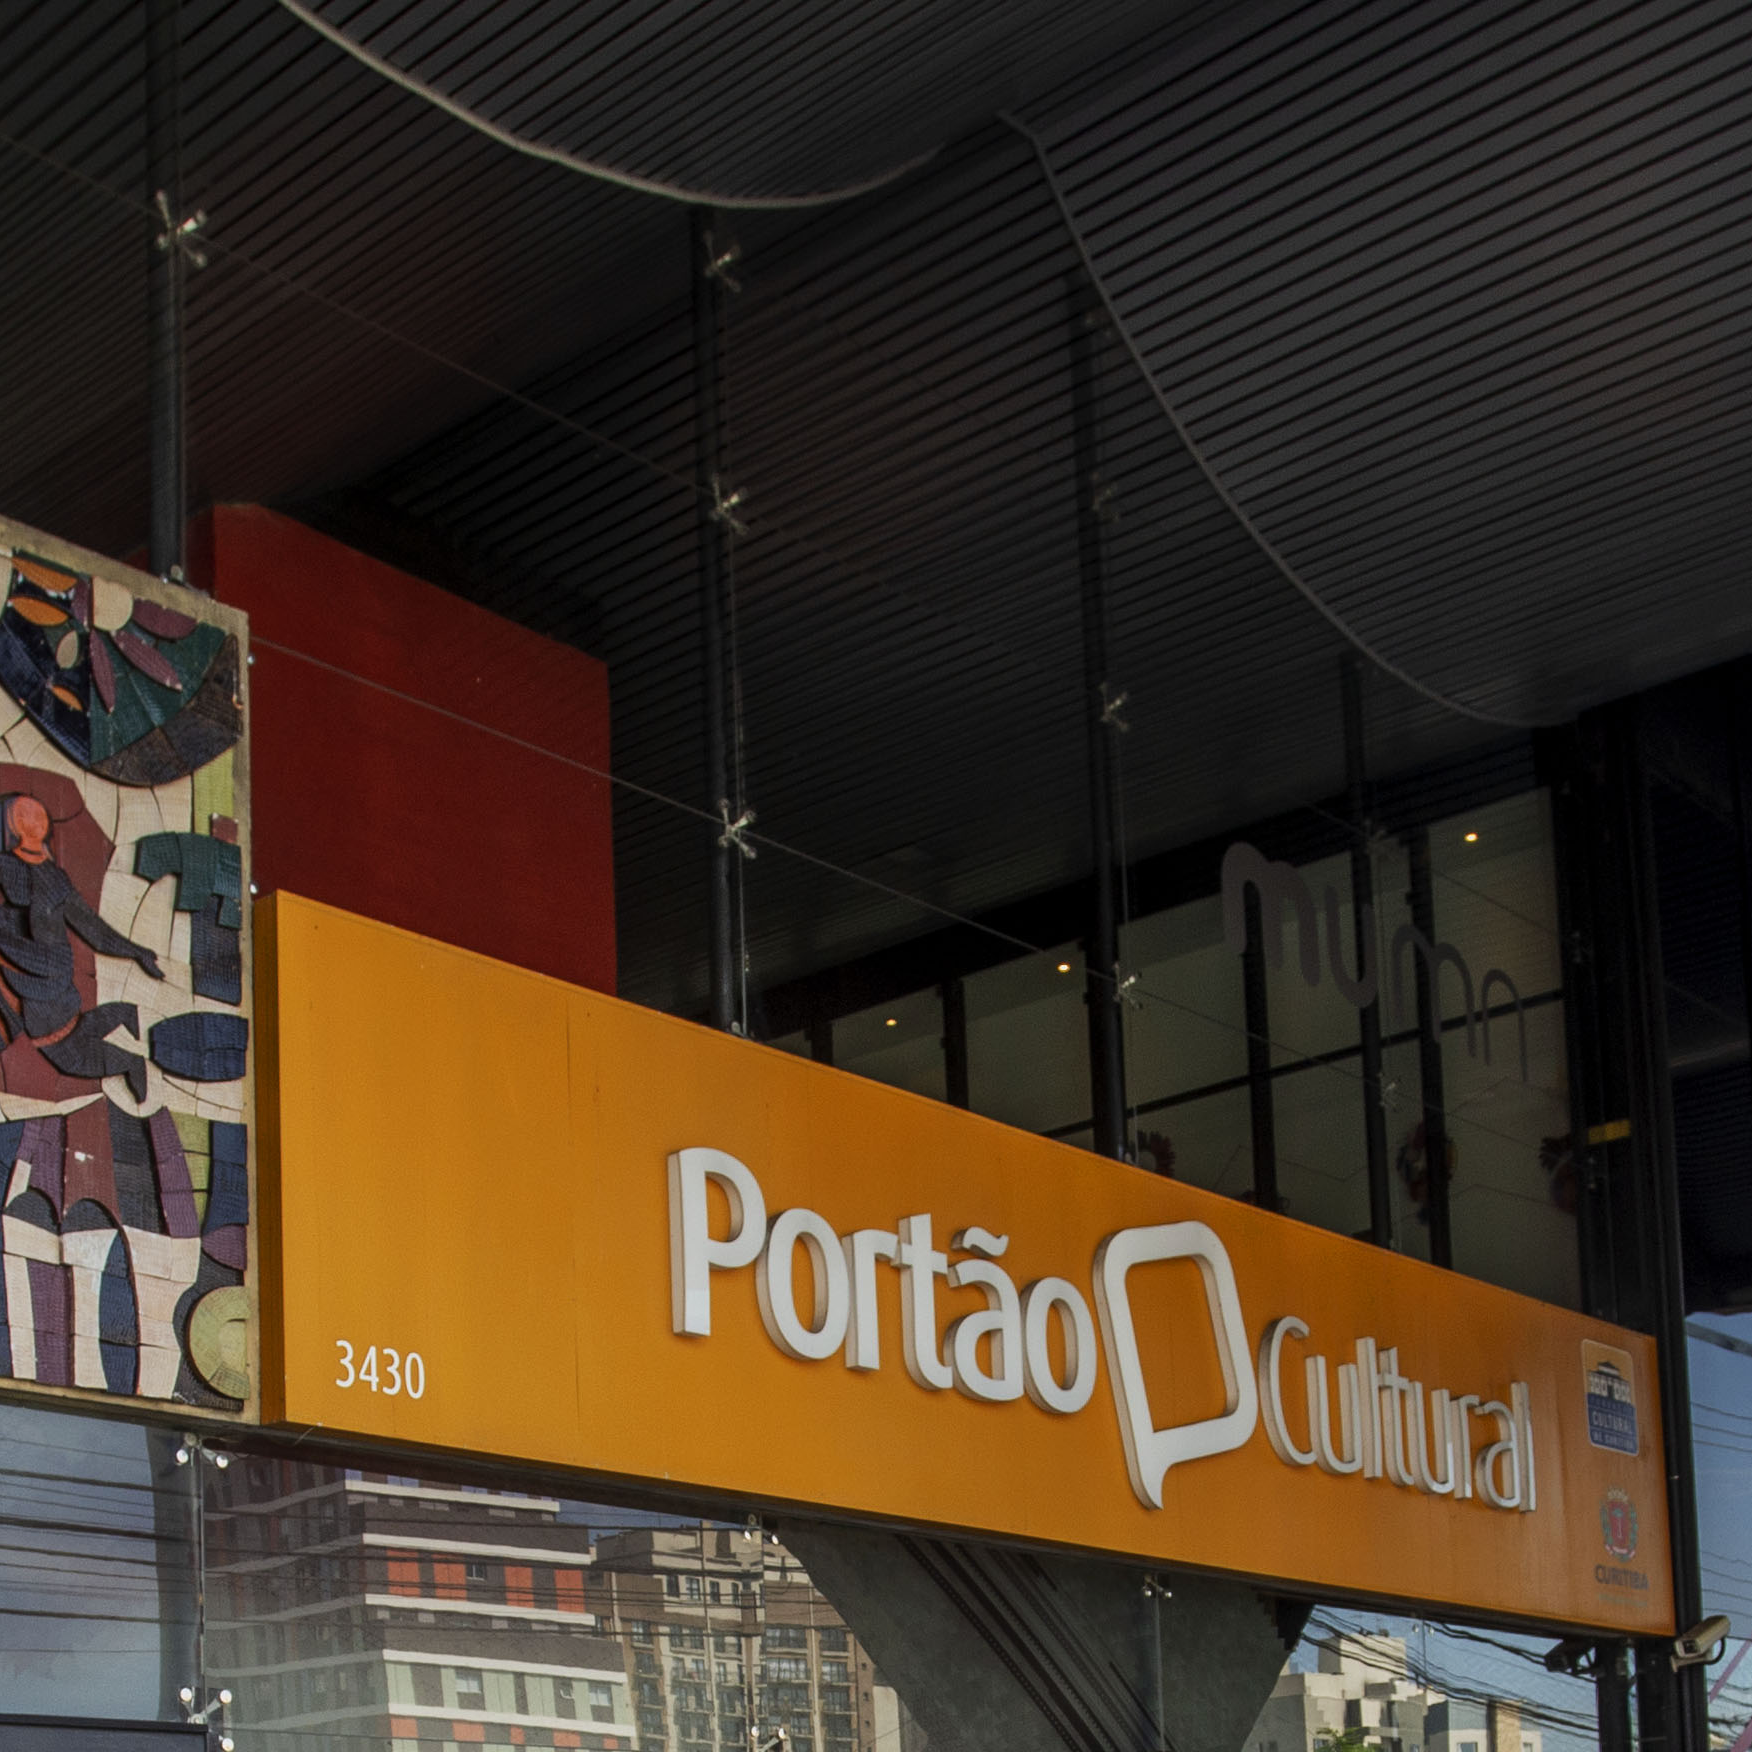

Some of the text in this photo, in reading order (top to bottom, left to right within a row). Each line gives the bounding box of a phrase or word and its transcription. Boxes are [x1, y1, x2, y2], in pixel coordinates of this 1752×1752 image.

[667, 1147, 1536, 1513] Portão Cultural
[335, 1339, 425, 1399] 3430
[1591, 1410, 1633, 1434] CULTURAL
[1595, 1565, 1649, 1590] CURITIBA
